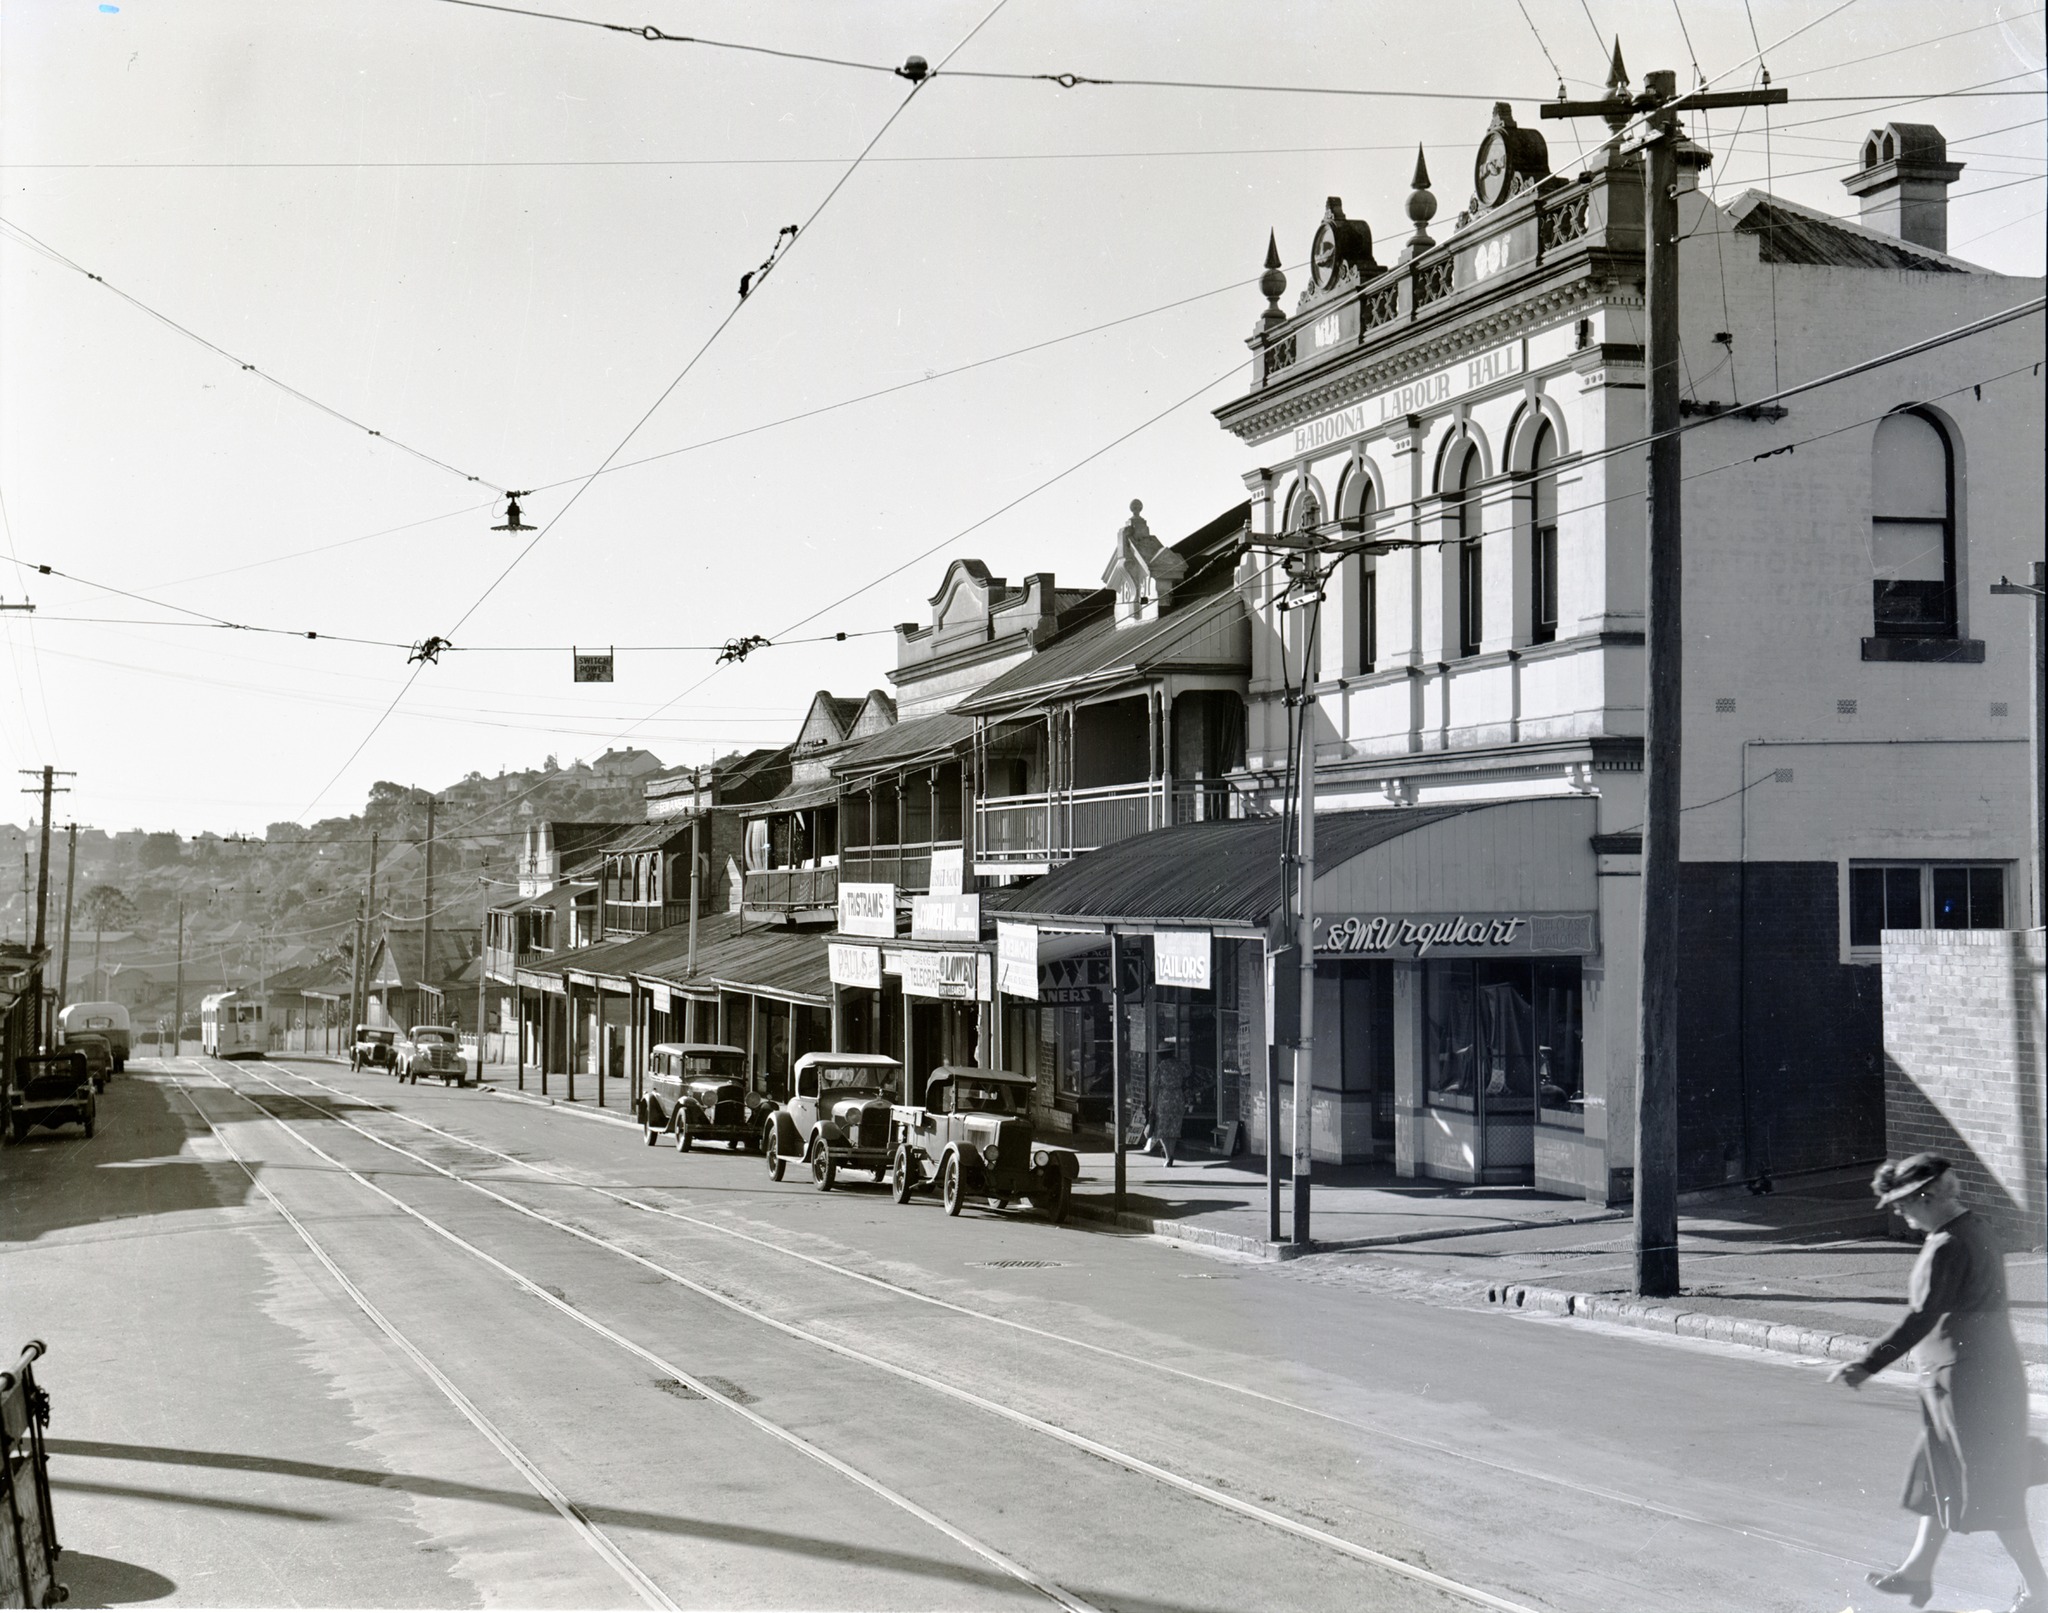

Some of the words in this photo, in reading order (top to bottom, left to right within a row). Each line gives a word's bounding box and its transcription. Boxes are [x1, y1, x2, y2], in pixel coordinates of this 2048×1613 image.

[1295, 406, 1366, 452] BAROONA
[1380, 372, 1451, 422] LABOUR
[1467, 345, 1520, 390] HALL
[578, 657, 609, 665] SWITCH
[580, 665, 607, 673] POWER
[586, 673, 602, 681] OFF
[1157, 952, 1206, 981] TAILORS
